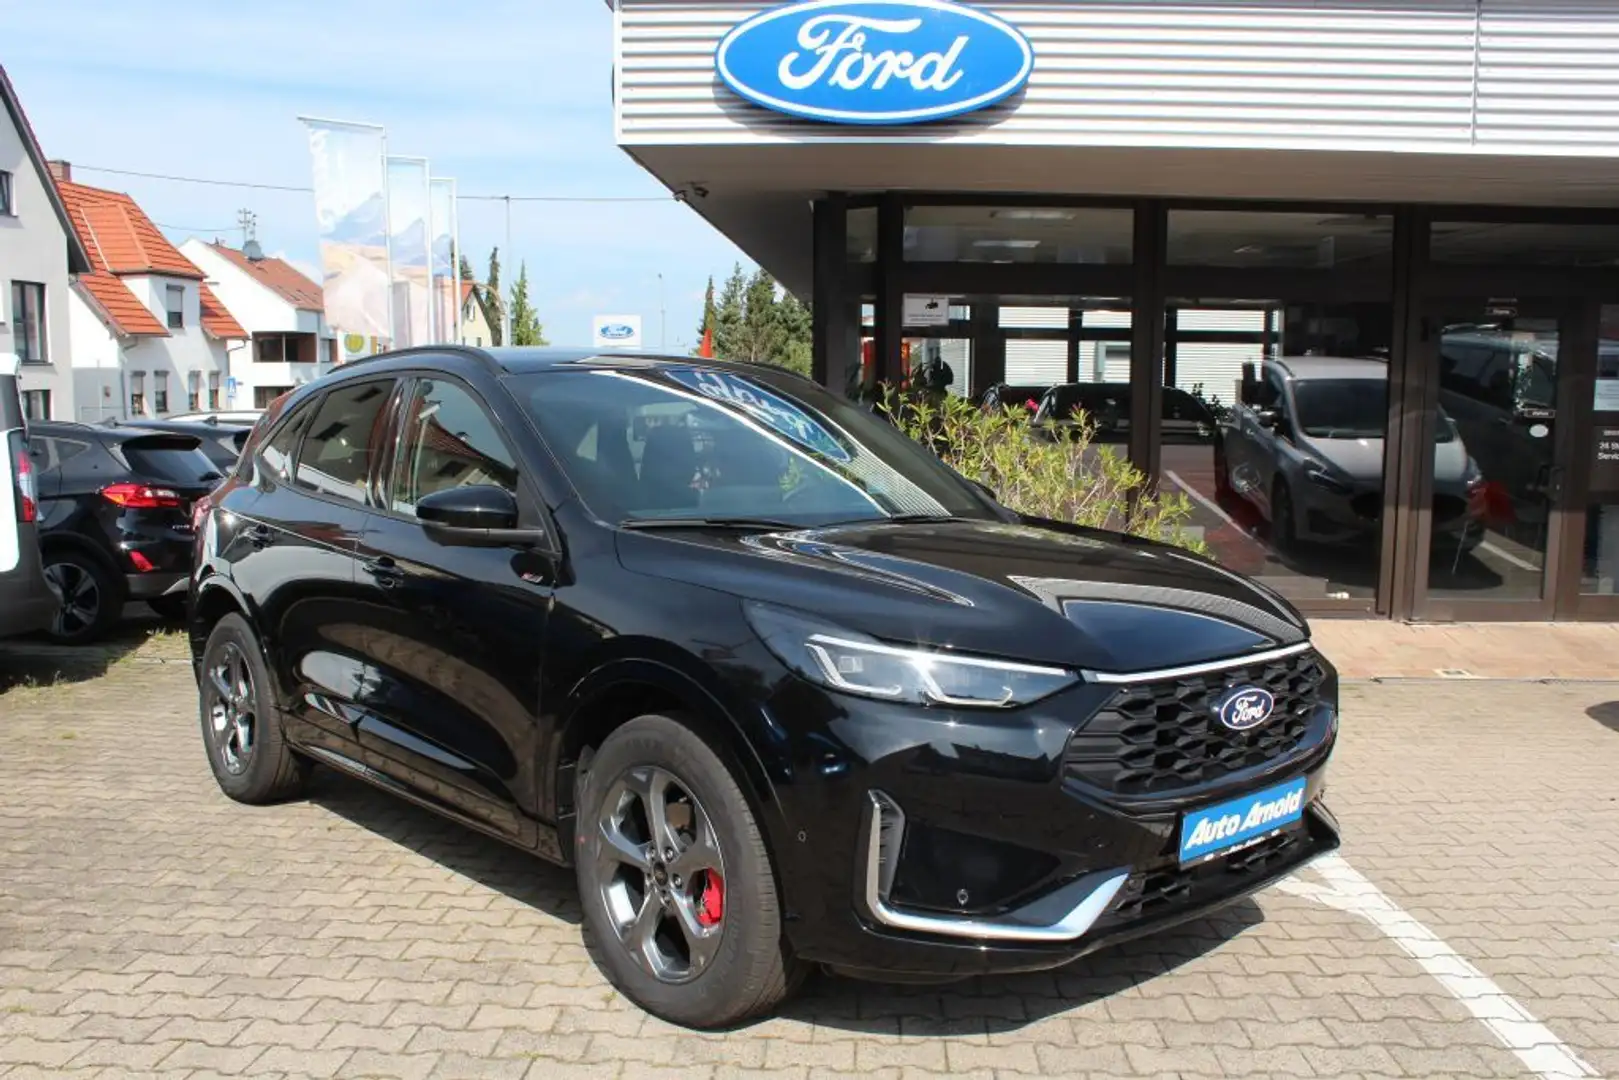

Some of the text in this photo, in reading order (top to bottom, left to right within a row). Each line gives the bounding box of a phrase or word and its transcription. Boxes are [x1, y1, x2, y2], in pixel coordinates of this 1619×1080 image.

[778, 14, 969, 91] Ford
[1232, 696, 1265, 723] Ford
[1184, 814, 1240, 850] Auto
[1239, 788, 1304, 832] Arnold
